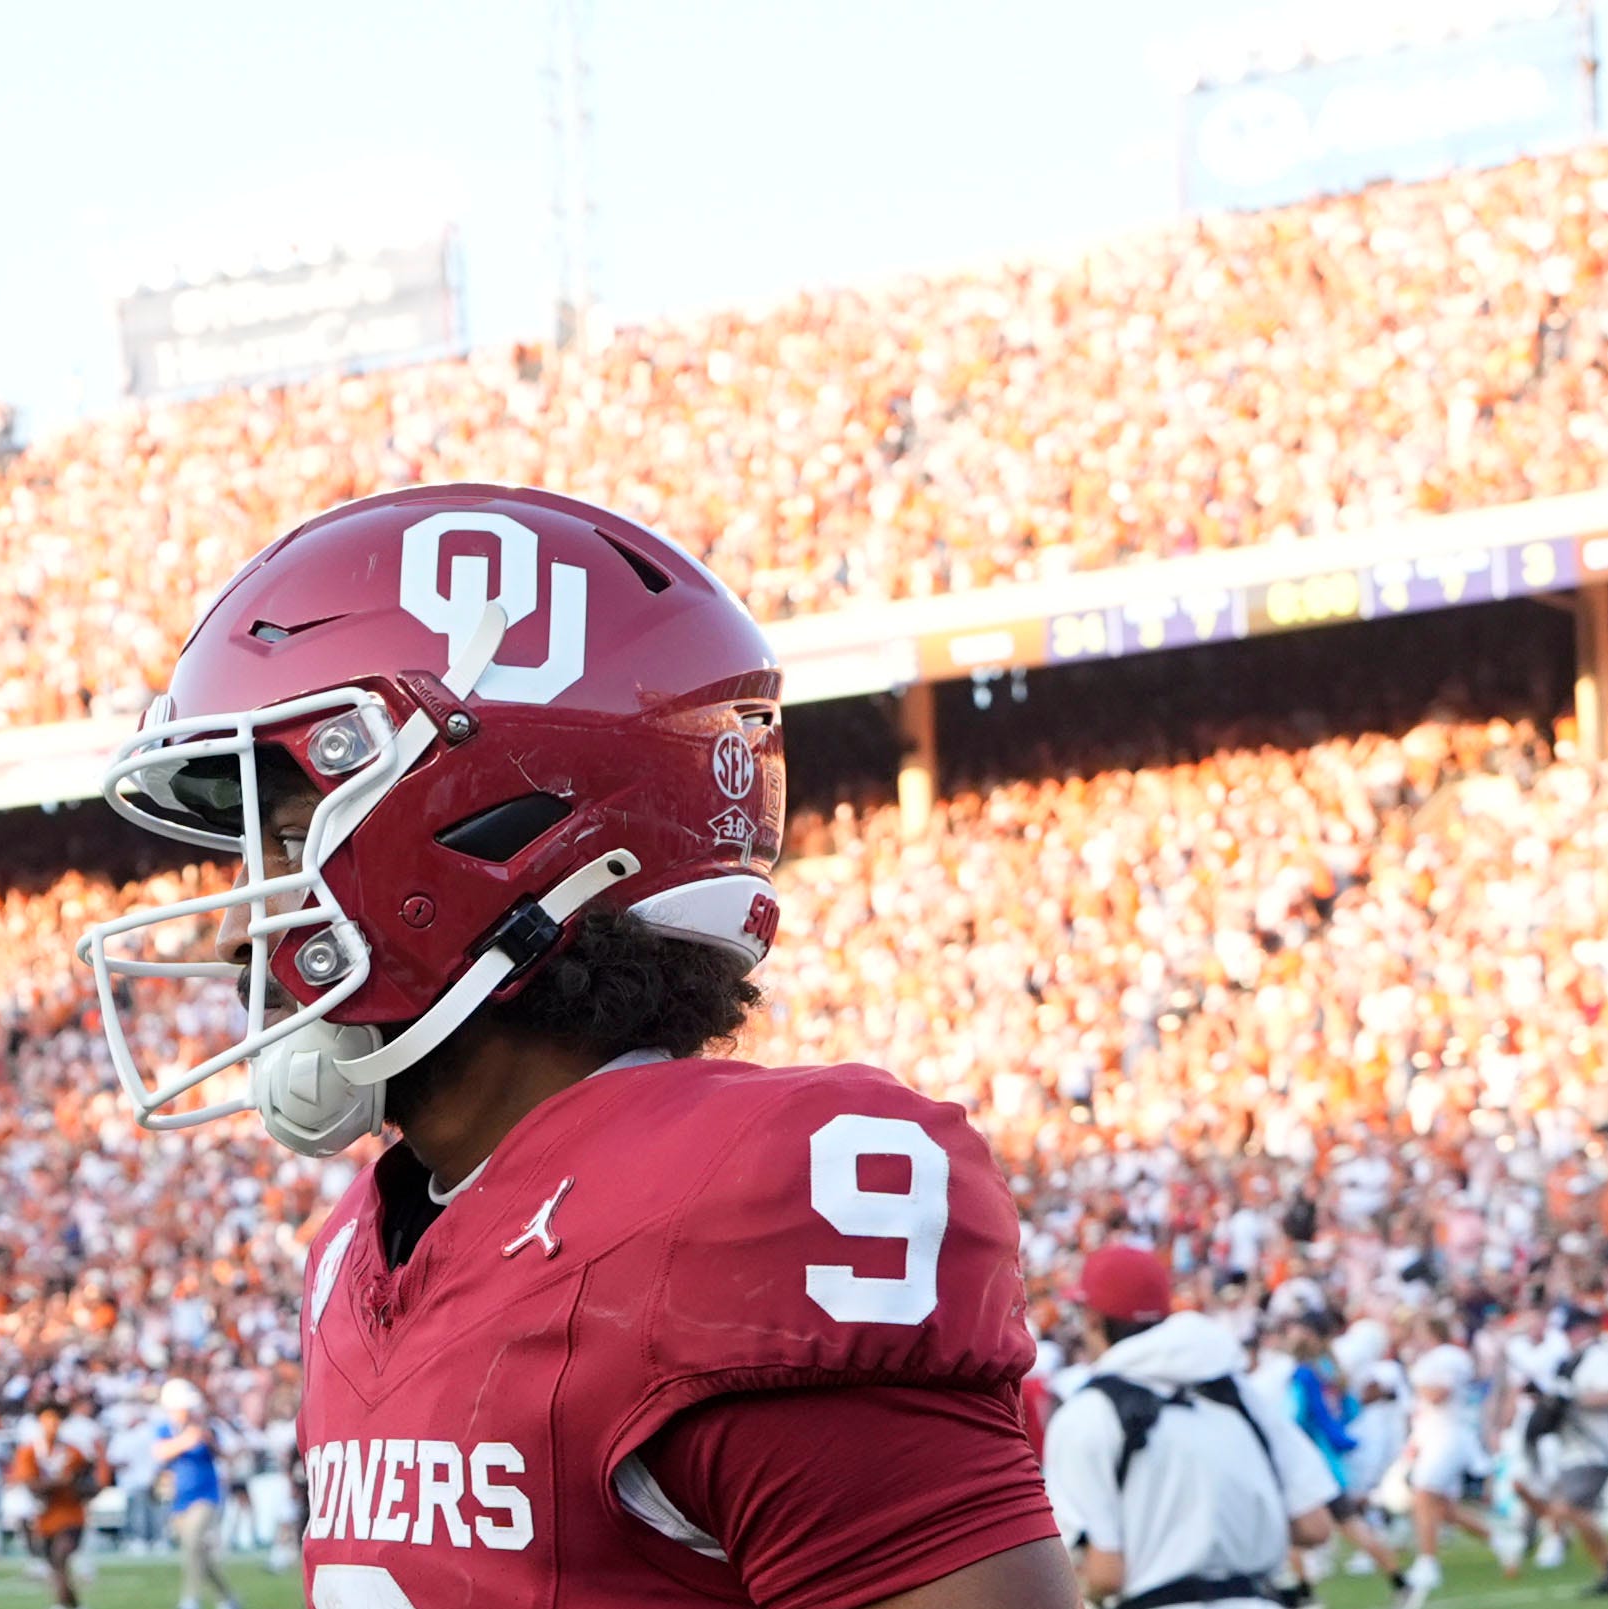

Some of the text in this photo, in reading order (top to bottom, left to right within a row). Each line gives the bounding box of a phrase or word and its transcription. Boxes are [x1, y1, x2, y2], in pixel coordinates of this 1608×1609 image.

[400, 512, 587, 705] OU
[716, 734, 753, 798] SEC
[723, 815, 745, 839] 3.0
[743, 893, 780, 958] SO
[806, 1114, 950, 1326] 9
[304, 1438, 534, 1550] OONERS
